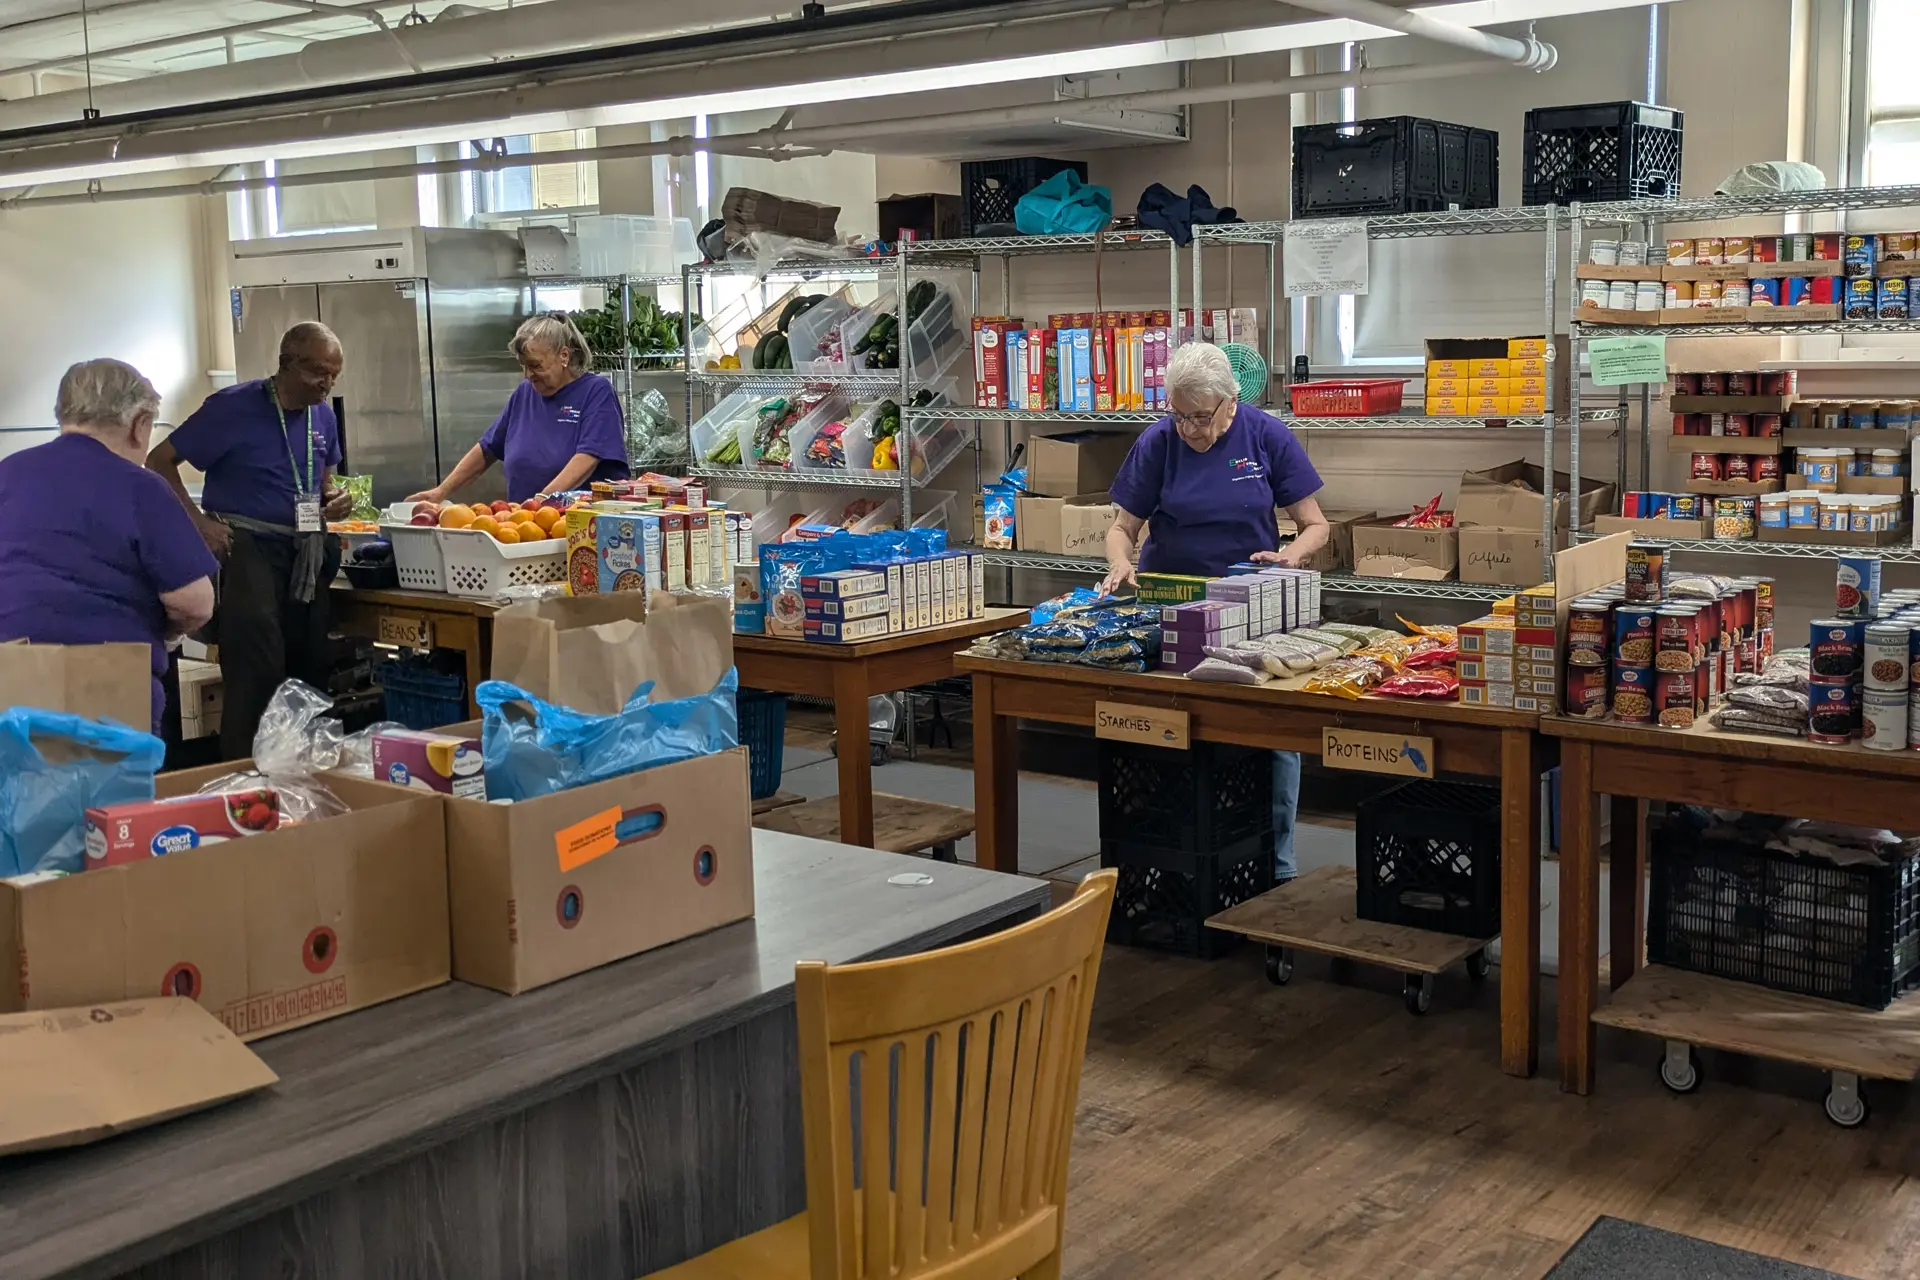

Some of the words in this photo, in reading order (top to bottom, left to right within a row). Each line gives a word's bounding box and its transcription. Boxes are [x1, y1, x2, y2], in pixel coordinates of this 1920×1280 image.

[1175, 584, 1193, 601] KIT
[381, 618, 416, 642] BEANS
[1098, 711, 1151, 732] STARCHES
[1327, 735, 1399, 764] PROTEINS
[118, 824, 130, 841] 8
[157, 831, 192, 848] Great
[165, 843, 192, 854] Value
[301, 993, 310, 1011] 12
[335, 983, 344, 1000] 15
